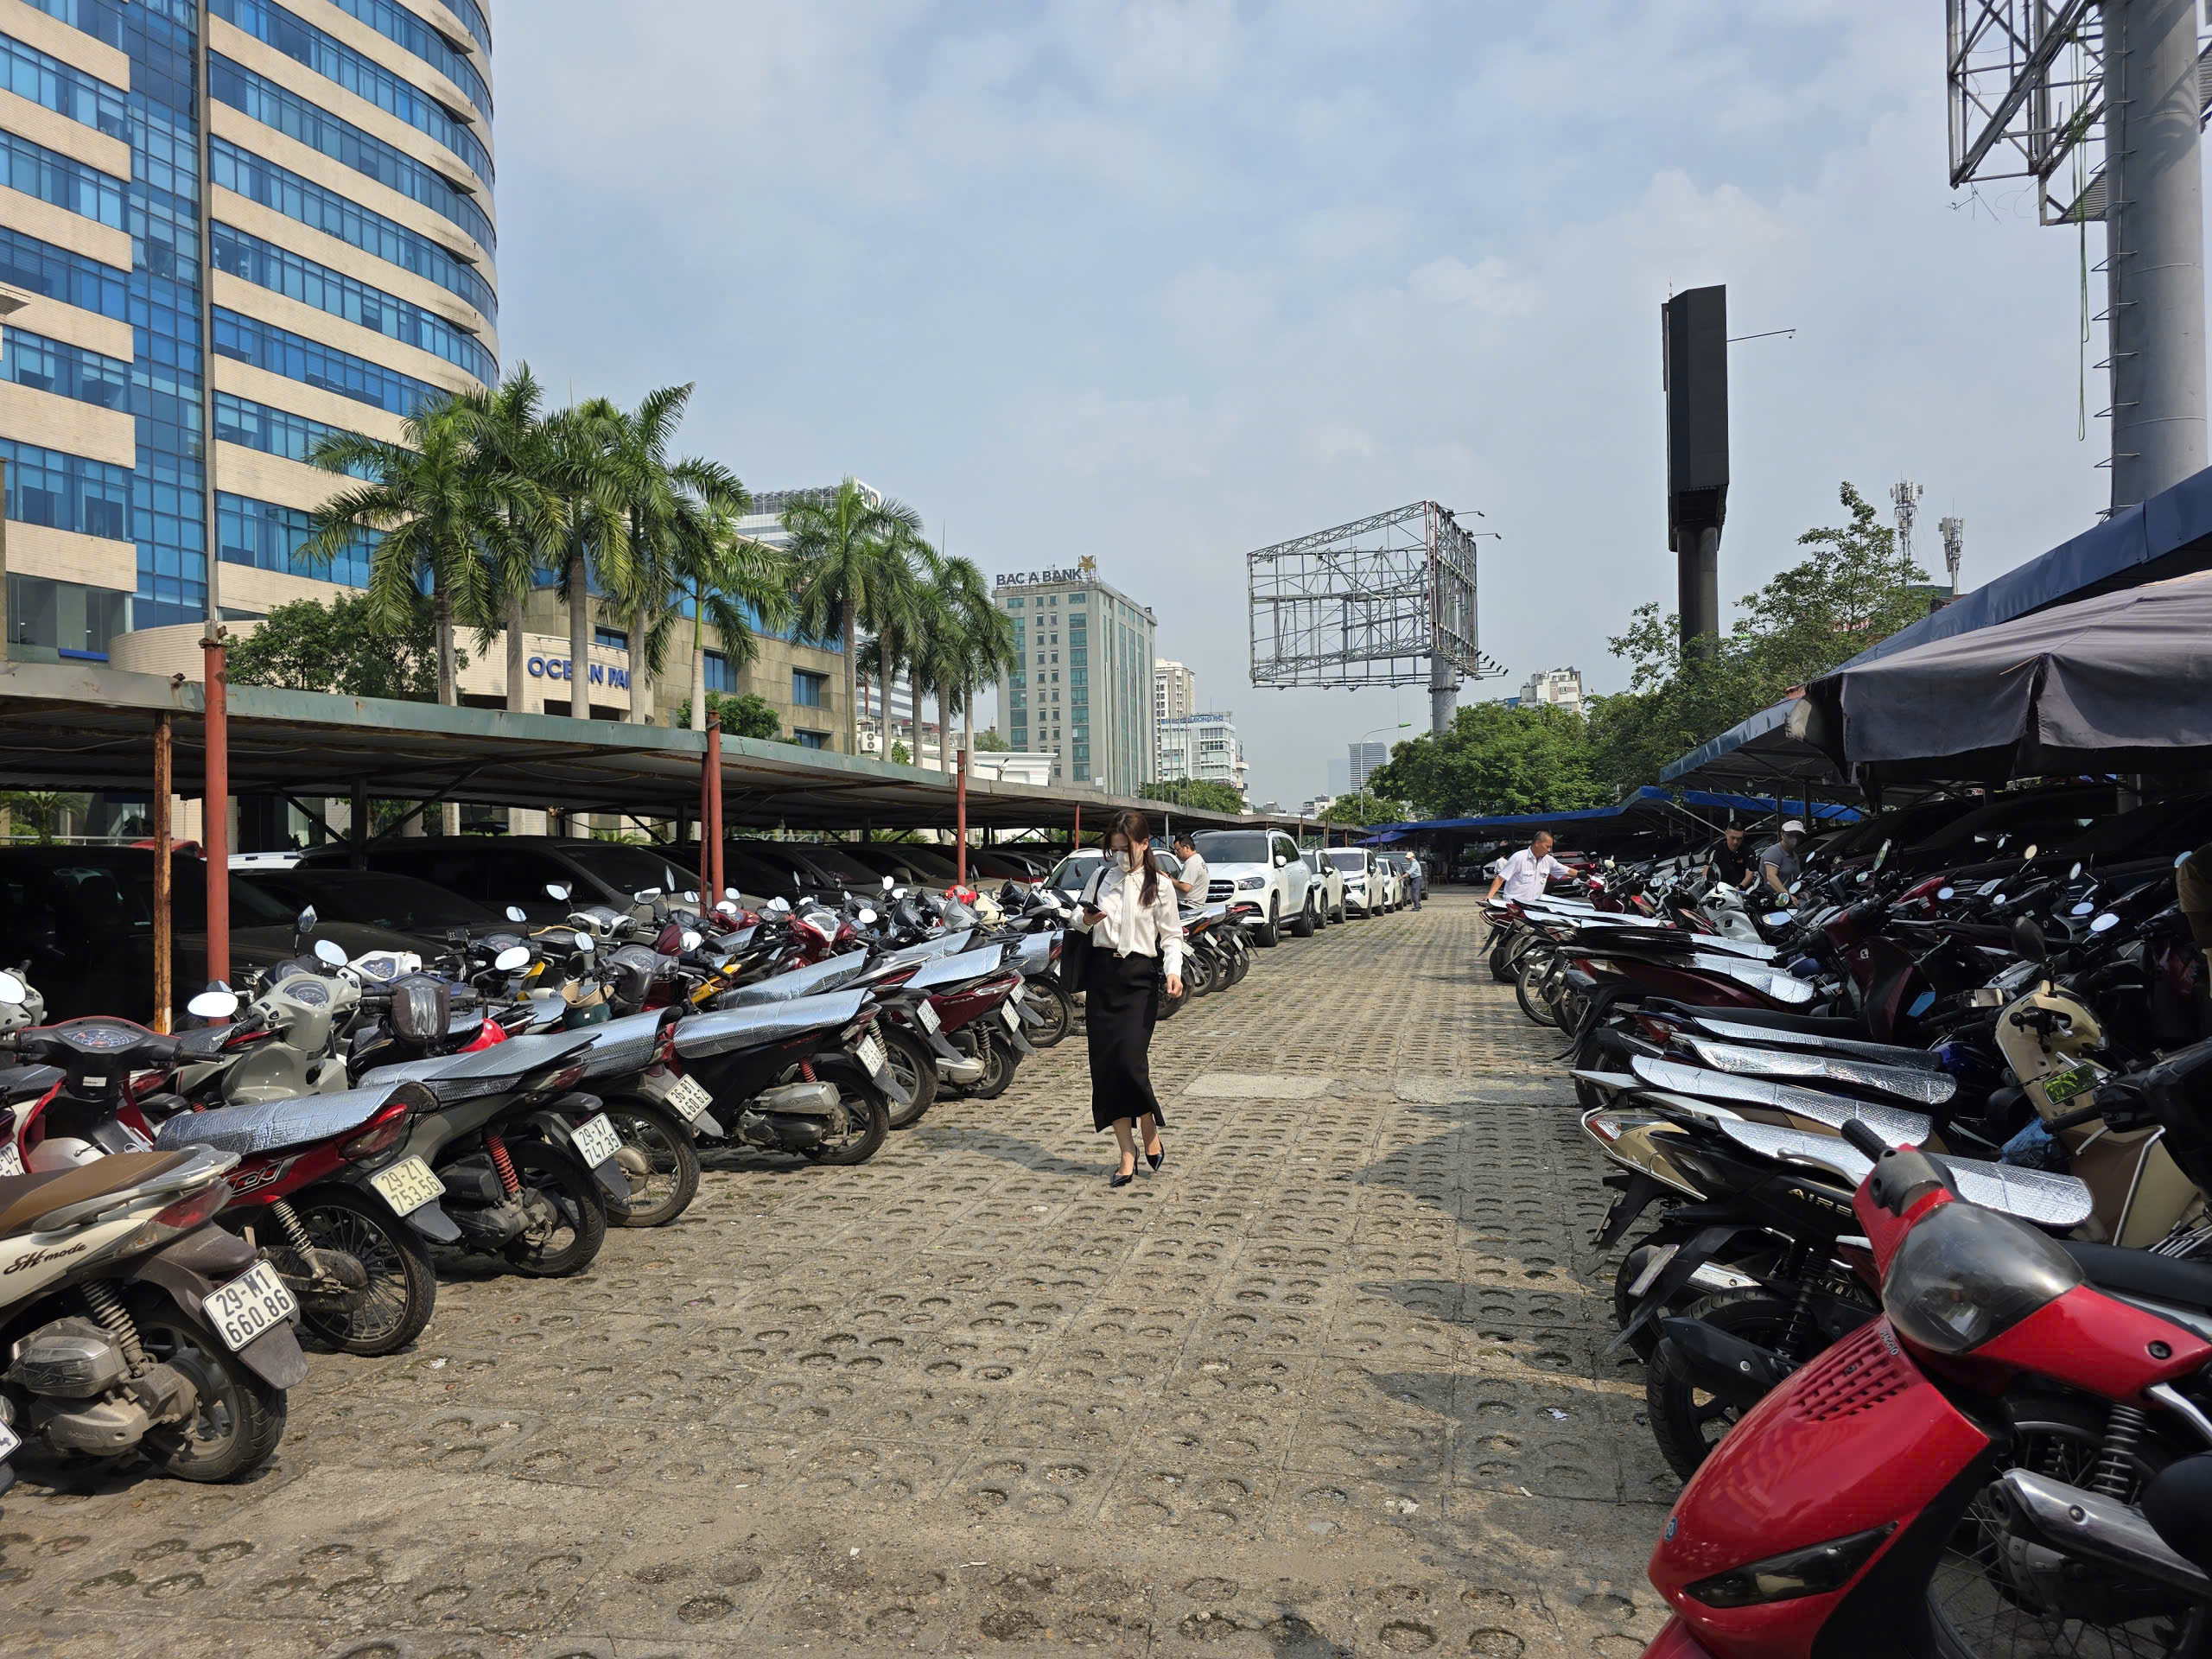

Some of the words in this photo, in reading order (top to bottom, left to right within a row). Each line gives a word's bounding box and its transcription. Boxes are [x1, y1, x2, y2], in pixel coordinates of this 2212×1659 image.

[996, 573, 1025, 585] BAC
[1029, 572, 1039, 583] A
[1042, 568, 1082, 582] BANK
[527, 657, 604, 685] OCEN
[671, 1079, 696, 1103] 36-B1
[579, 1119, 606, 1146] 29-X7
[585, 1133, 620, 1165] 747.35
[381, 1160, 423, 1192] 29-Z1
[391, 1176, 440, 1212] 753.56
[44, 1243, 87, 1262] mode
[215, 1269, 271, 1318] 29-M1
[226, 1288, 290, 1344] 660.86
